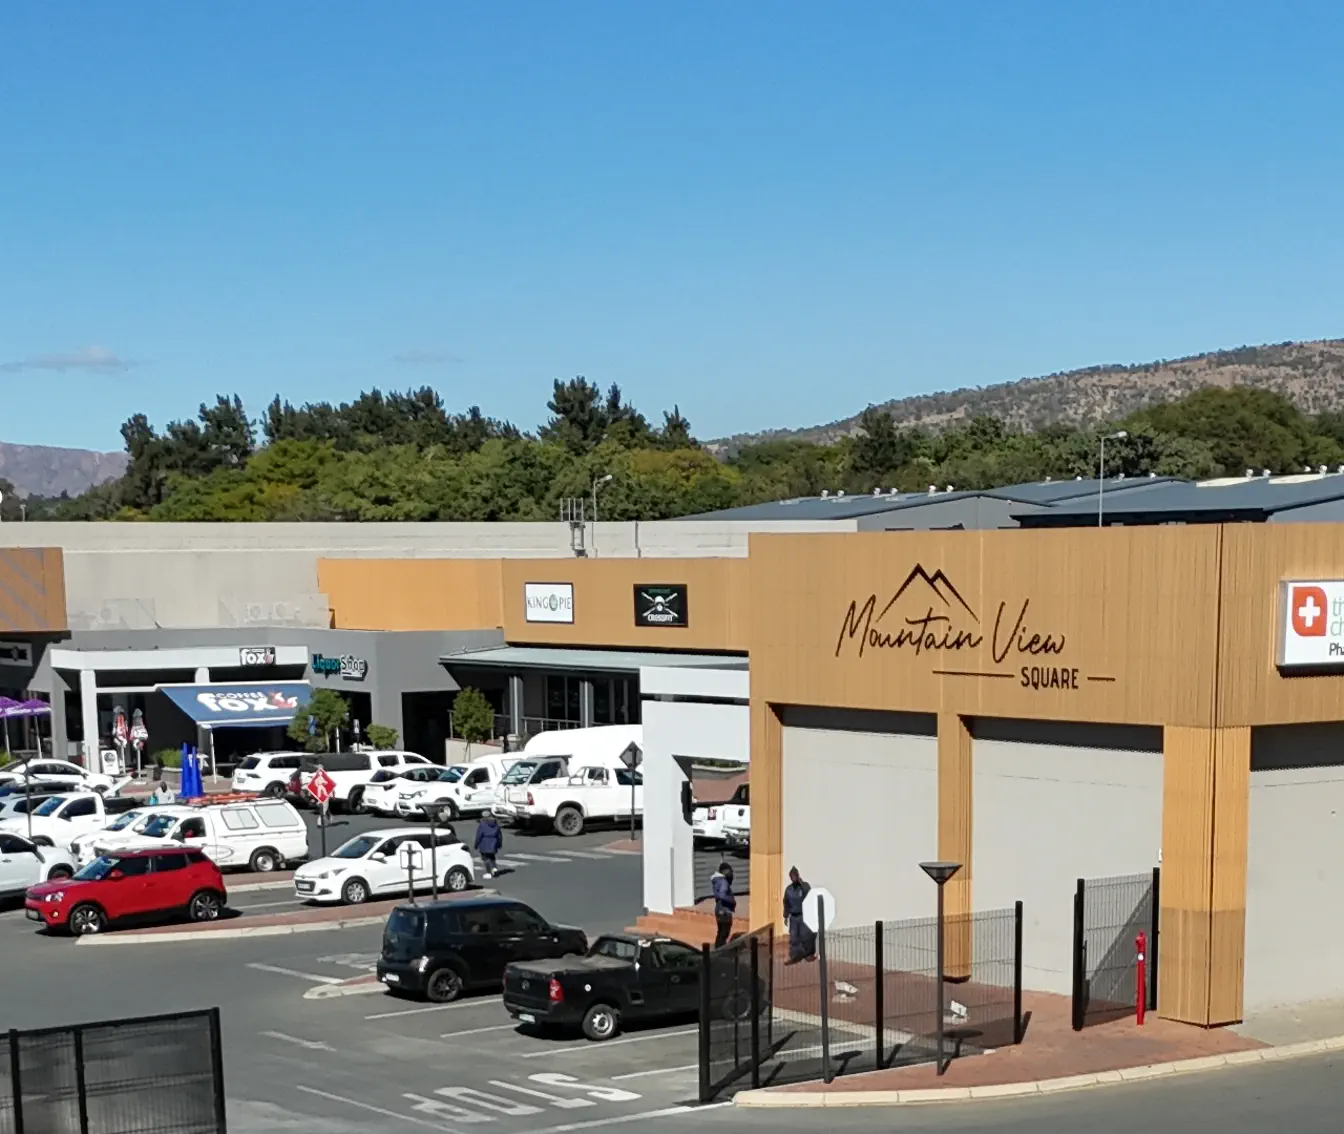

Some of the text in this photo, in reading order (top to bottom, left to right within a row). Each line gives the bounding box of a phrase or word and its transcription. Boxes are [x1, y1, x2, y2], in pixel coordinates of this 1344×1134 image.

[527, 596, 571, 609] KING PIE
[836, 594, 1066, 664] Mountain View
[1020, 666, 1079, 690] SQUARE
[402, 1072, 642, 1124] STOP
